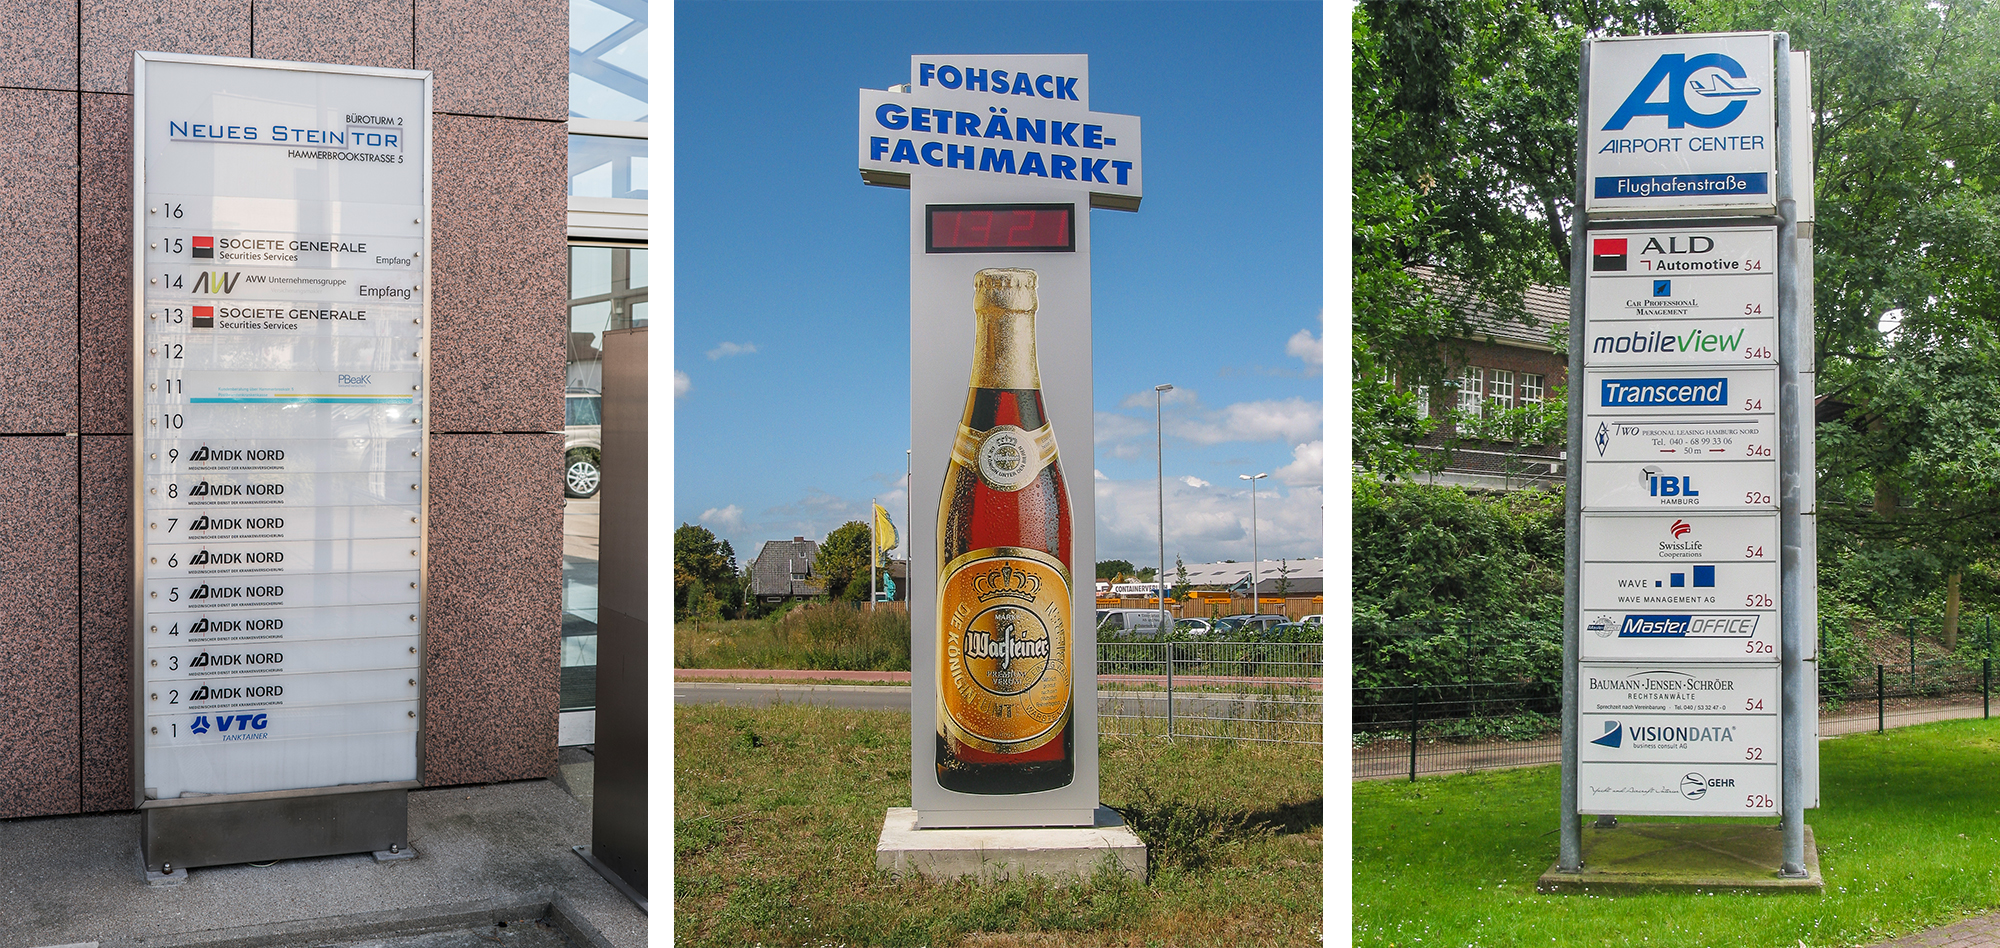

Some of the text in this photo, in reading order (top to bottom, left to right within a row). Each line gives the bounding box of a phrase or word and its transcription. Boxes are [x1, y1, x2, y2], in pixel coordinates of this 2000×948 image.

[920, 63, 1079, 101] FOHSACK
[346, 114, 403, 125] BÜROTURM 2
[875, 103, 1116, 149] GETRÄNKE-
[170, 121, 257, 139] NEUES
[1599, 136, 1764, 154] AIRPORT CENTER
[288, 150, 403, 163] HAMMERBROOKSTRASSE 5
[870, 136, 1132, 185] FACHMARKT
[1618, 176, 1747, 196] Flughafenstraße
[164, 203, 183, 218] 16
[164, 238, 366, 253] 15 SOCIETE GENERALE
[1641, 237, 1714, 254] ALD
[220, 251, 298, 262] Securities Services
[376, 256, 411, 266] Empfang
[1656, 260, 1761, 271] Automotive 54
[164, 274, 183, 289] 14
[269, 277, 346, 286] Unternehmensgruppe
[360, 285, 411, 299] Empfang
[164, 308, 366, 323] 13 SOCIETE GENERALE
[1744, 304, 1761, 315] 54
[220, 321, 297, 330] Securities Services
[164, 344, 183, 359] 12
[1744, 347, 1771, 359] 54b
[166, 379, 181, 393] 11
[1606, 382, 1722, 402] Transcend
[1744, 399, 1762, 411] 54
[164, 414, 183, 429] 10
[169, 449, 284, 463] 9 MDK NORD
[1746, 445, 1771, 457] 54a
[169, 484, 284, 498] 8 MDK NORD
[1651, 476, 1699, 496] IBL
[1745, 492, 1771, 504] 52a
[168, 518, 284, 533] 7 MDK NORD
[1659, 546, 1763, 559] Cooperations 54
[168, 552, 284, 568] 6 MDK NORD
[1618, 580, 1647, 588] WAVE
[169, 586, 284, 602] 5 MDK NORD
[1745, 594, 1772, 607] 52b
[169, 619, 283, 636] 4 MDK NORD
[1746, 641, 1773, 654] 52a
[169, 653, 283, 670] 3 MDK NORD
[948, 631, 977, 704] KÖNIGIN
[169, 686, 283, 704] 2 MDK NORD
[1628, 692, 1695, 700] RECHTSANWÄLTE
[1745, 698, 1763, 710] 54
[172, 714, 268, 737] 1 VTG
[222, 733, 268, 741] TANKTAINER
[1746, 748, 1762, 760] 52
[1708, 779, 1735, 787] GEHR
[1746, 795, 1773, 808] 52b
